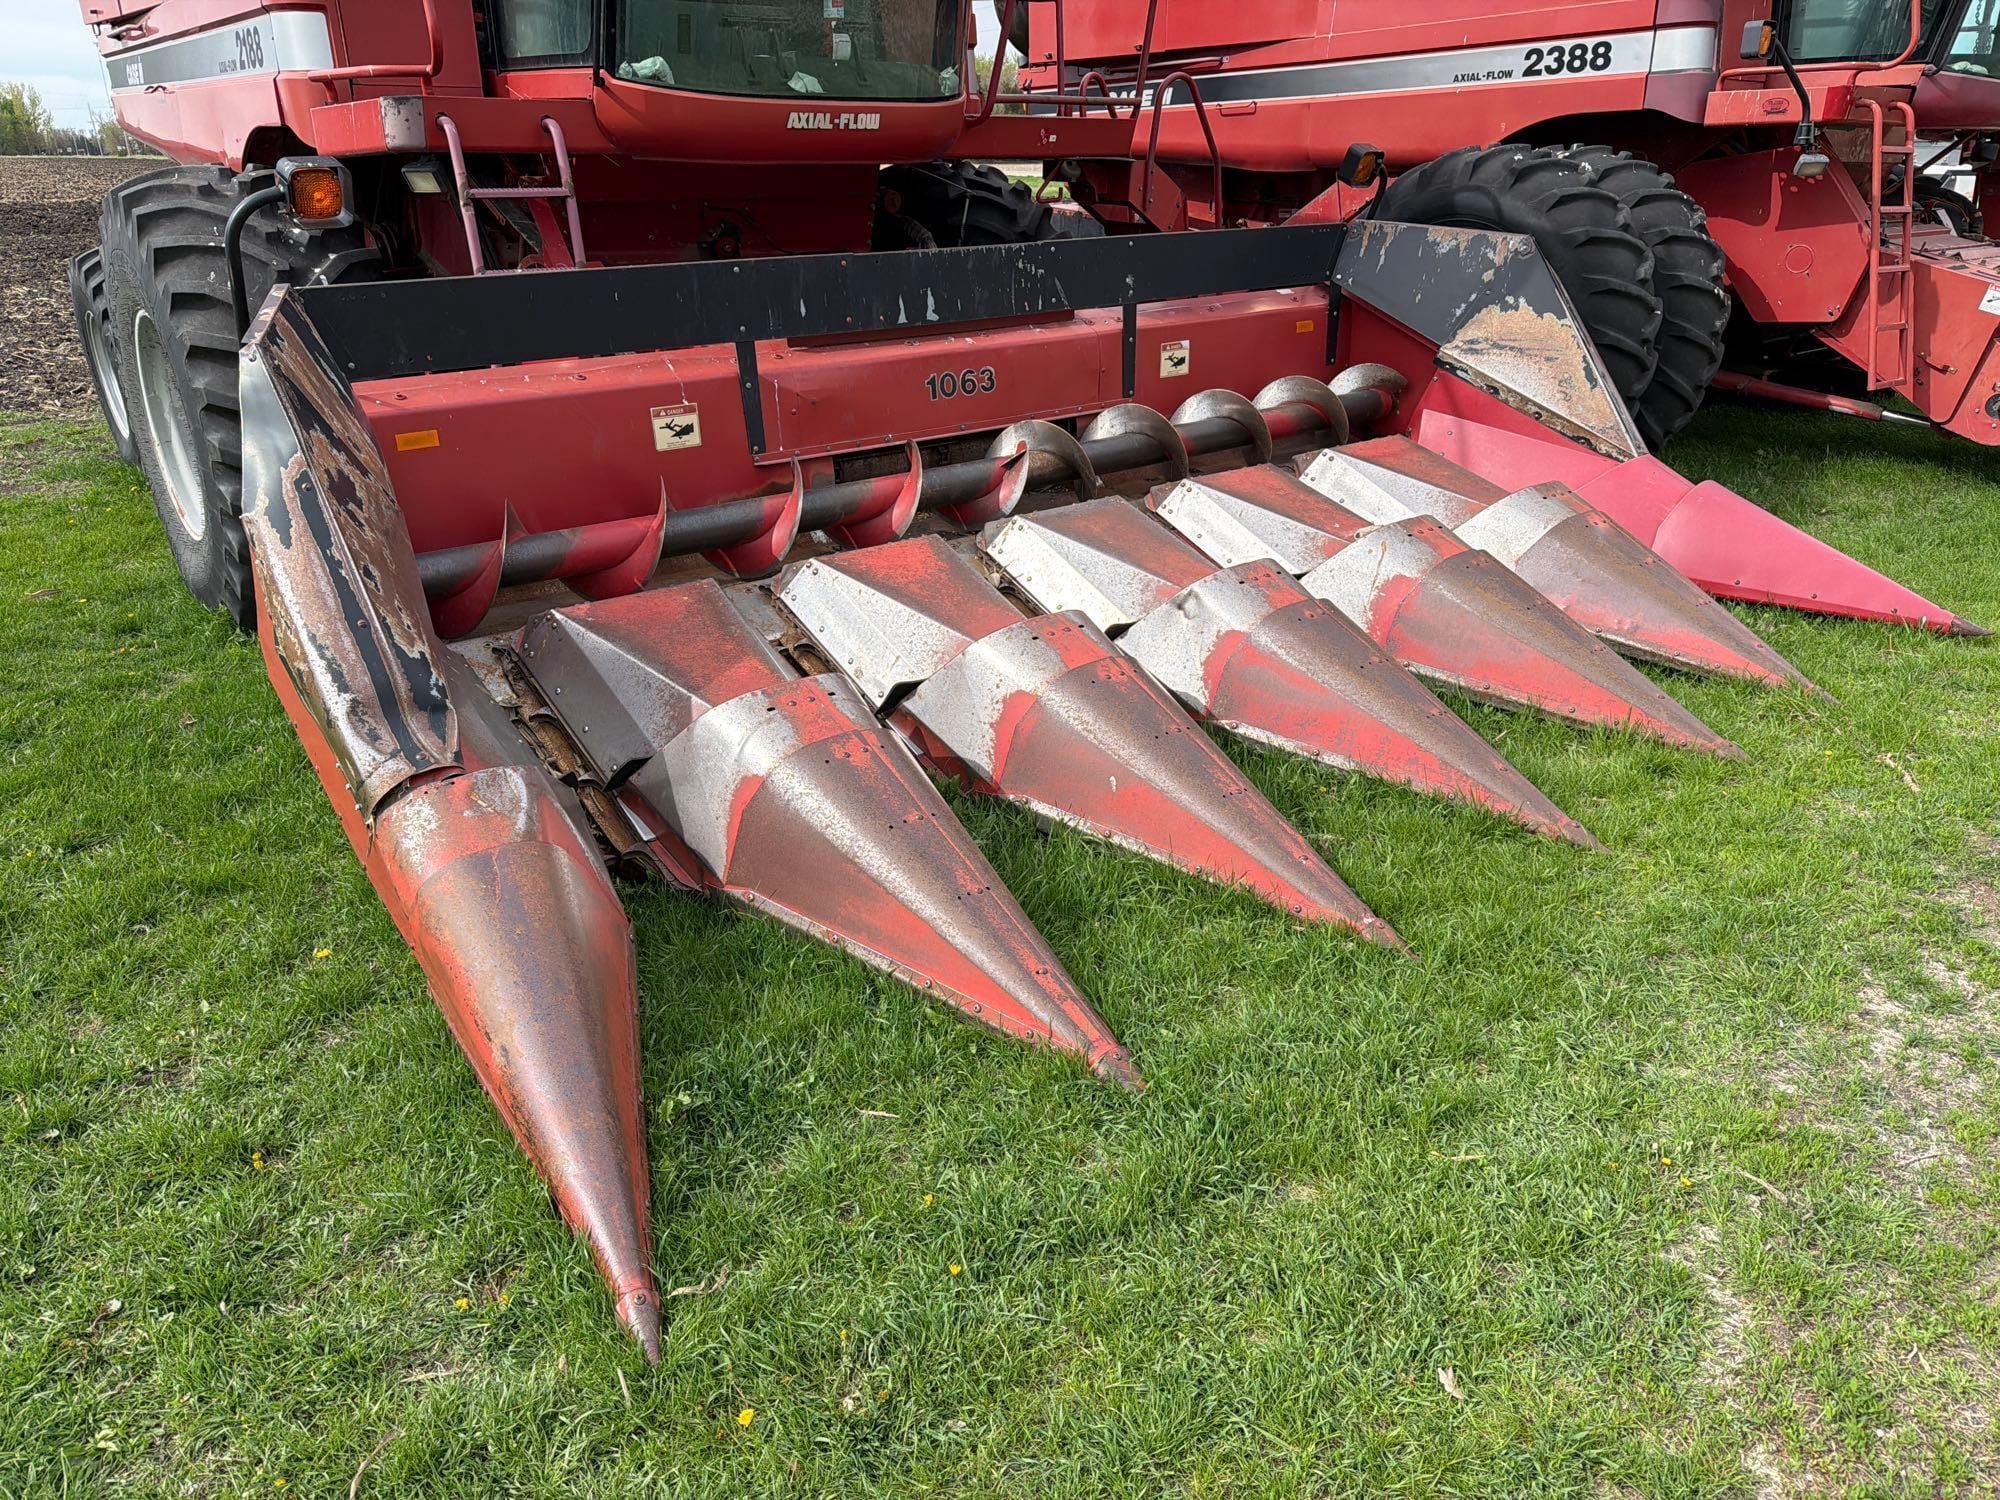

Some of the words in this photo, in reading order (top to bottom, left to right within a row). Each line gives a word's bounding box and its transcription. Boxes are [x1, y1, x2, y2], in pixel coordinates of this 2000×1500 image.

[235, 26, 263, 70] 2188
[1452, 69, 1514, 83] AXIAL-FLOW
[1521, 41, 1613, 78] 2388
[786, 111, 881, 130] AXIAL-FLOW
[925, 366, 997, 401] 1063
